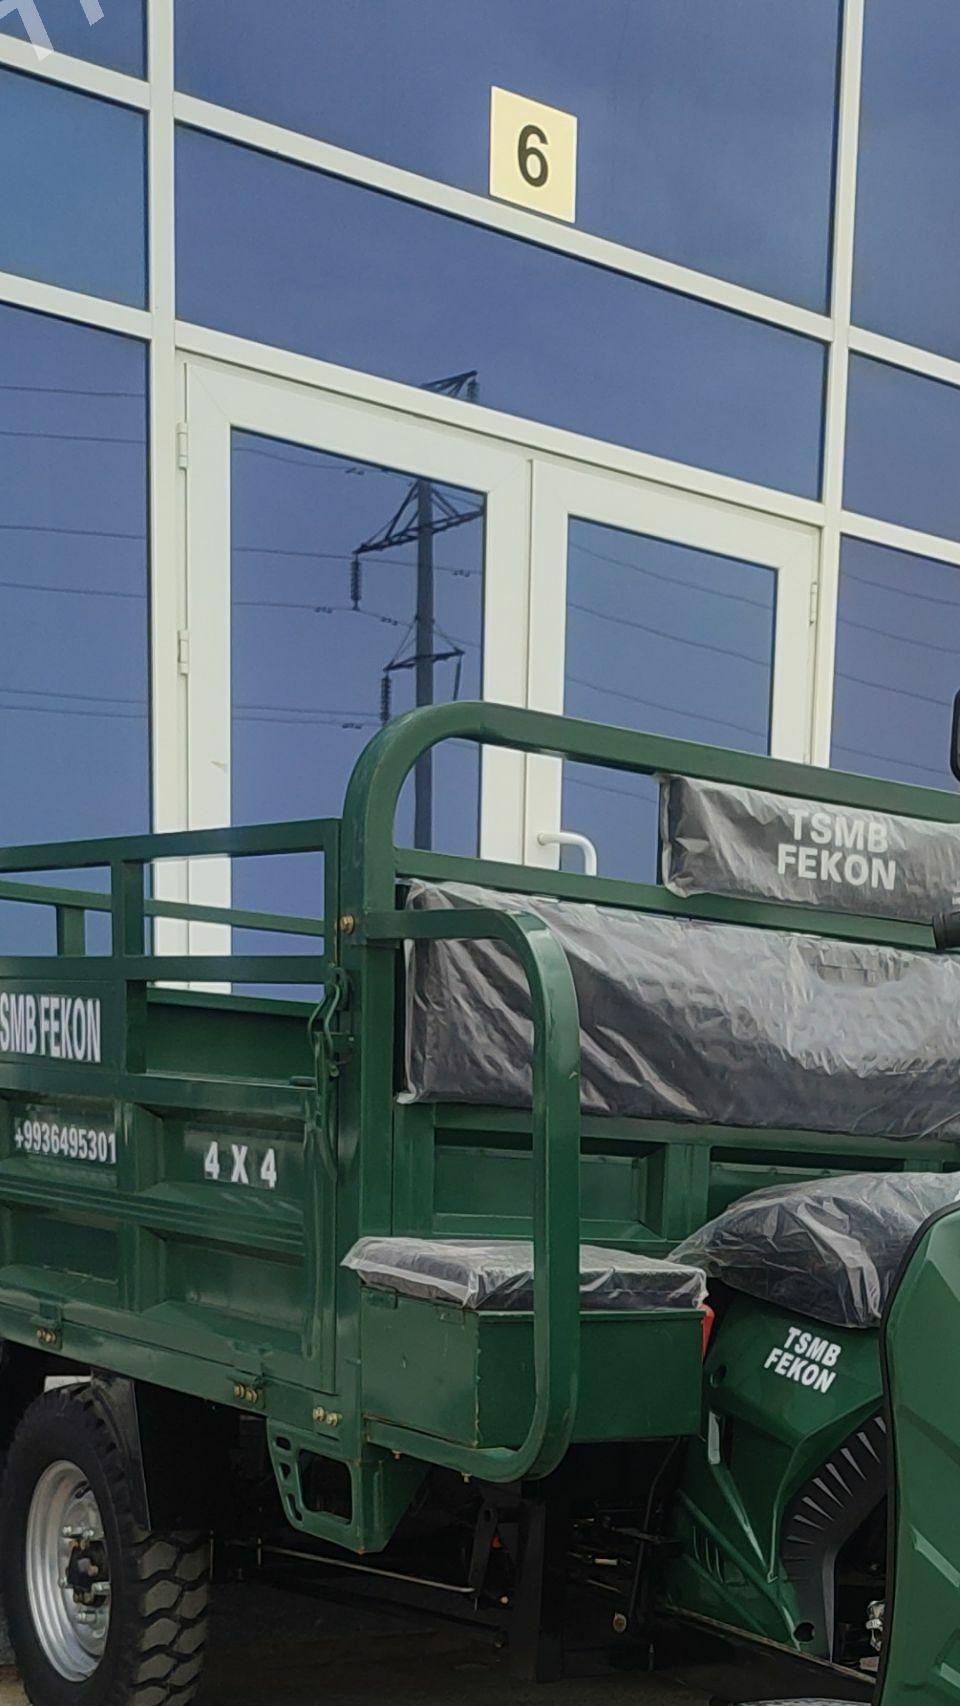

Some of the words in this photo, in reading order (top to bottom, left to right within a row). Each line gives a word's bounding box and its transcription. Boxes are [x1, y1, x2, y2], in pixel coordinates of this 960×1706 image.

[516, 124, 549, 188] 6
[787, 808, 889, 853] TSMB
[777, 843, 896, 890] FEKON
[40, 994, 101, 1063] FEKON
[14, 1120, 117, 1164] +9936495301
[204, 1141, 220, 1180] 4
[260, 1148, 277, 1188] 4
[784, 1326, 842, 1367] TSMB
[763, 1347, 837, 1394] FEKON
